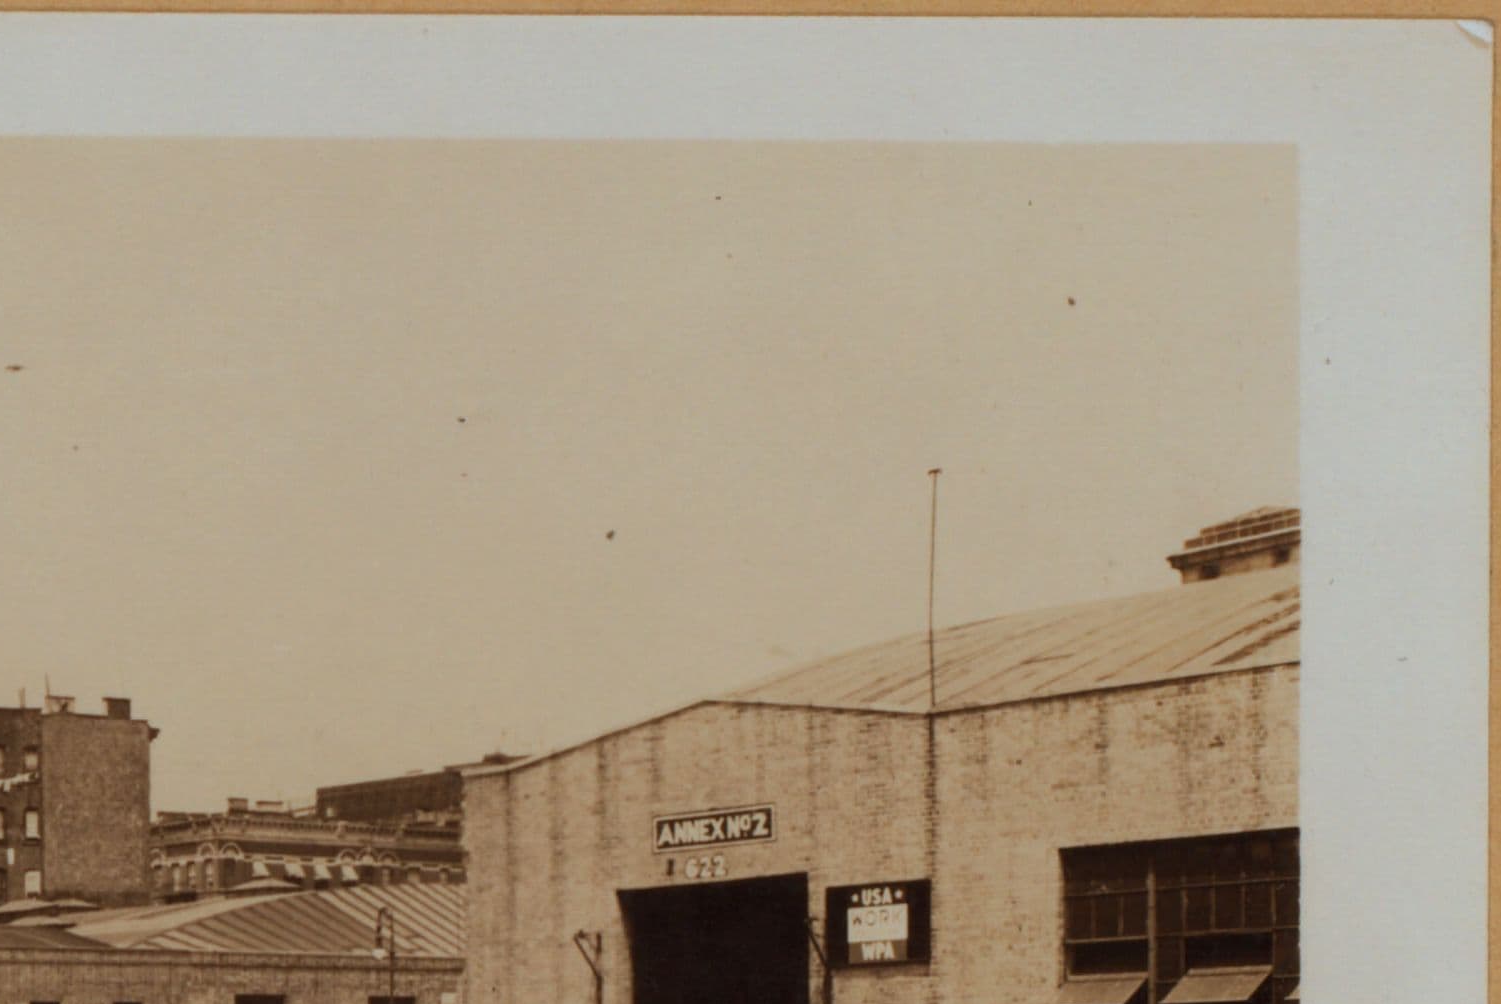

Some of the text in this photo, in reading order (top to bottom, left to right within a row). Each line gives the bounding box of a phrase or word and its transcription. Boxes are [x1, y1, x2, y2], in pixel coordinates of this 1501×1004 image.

[658, 815, 725, 846] ANNEX
[685, 855, 726, 879] 622
[861, 887, 892, 905] USA
[862, 942, 895, 960] WPA
